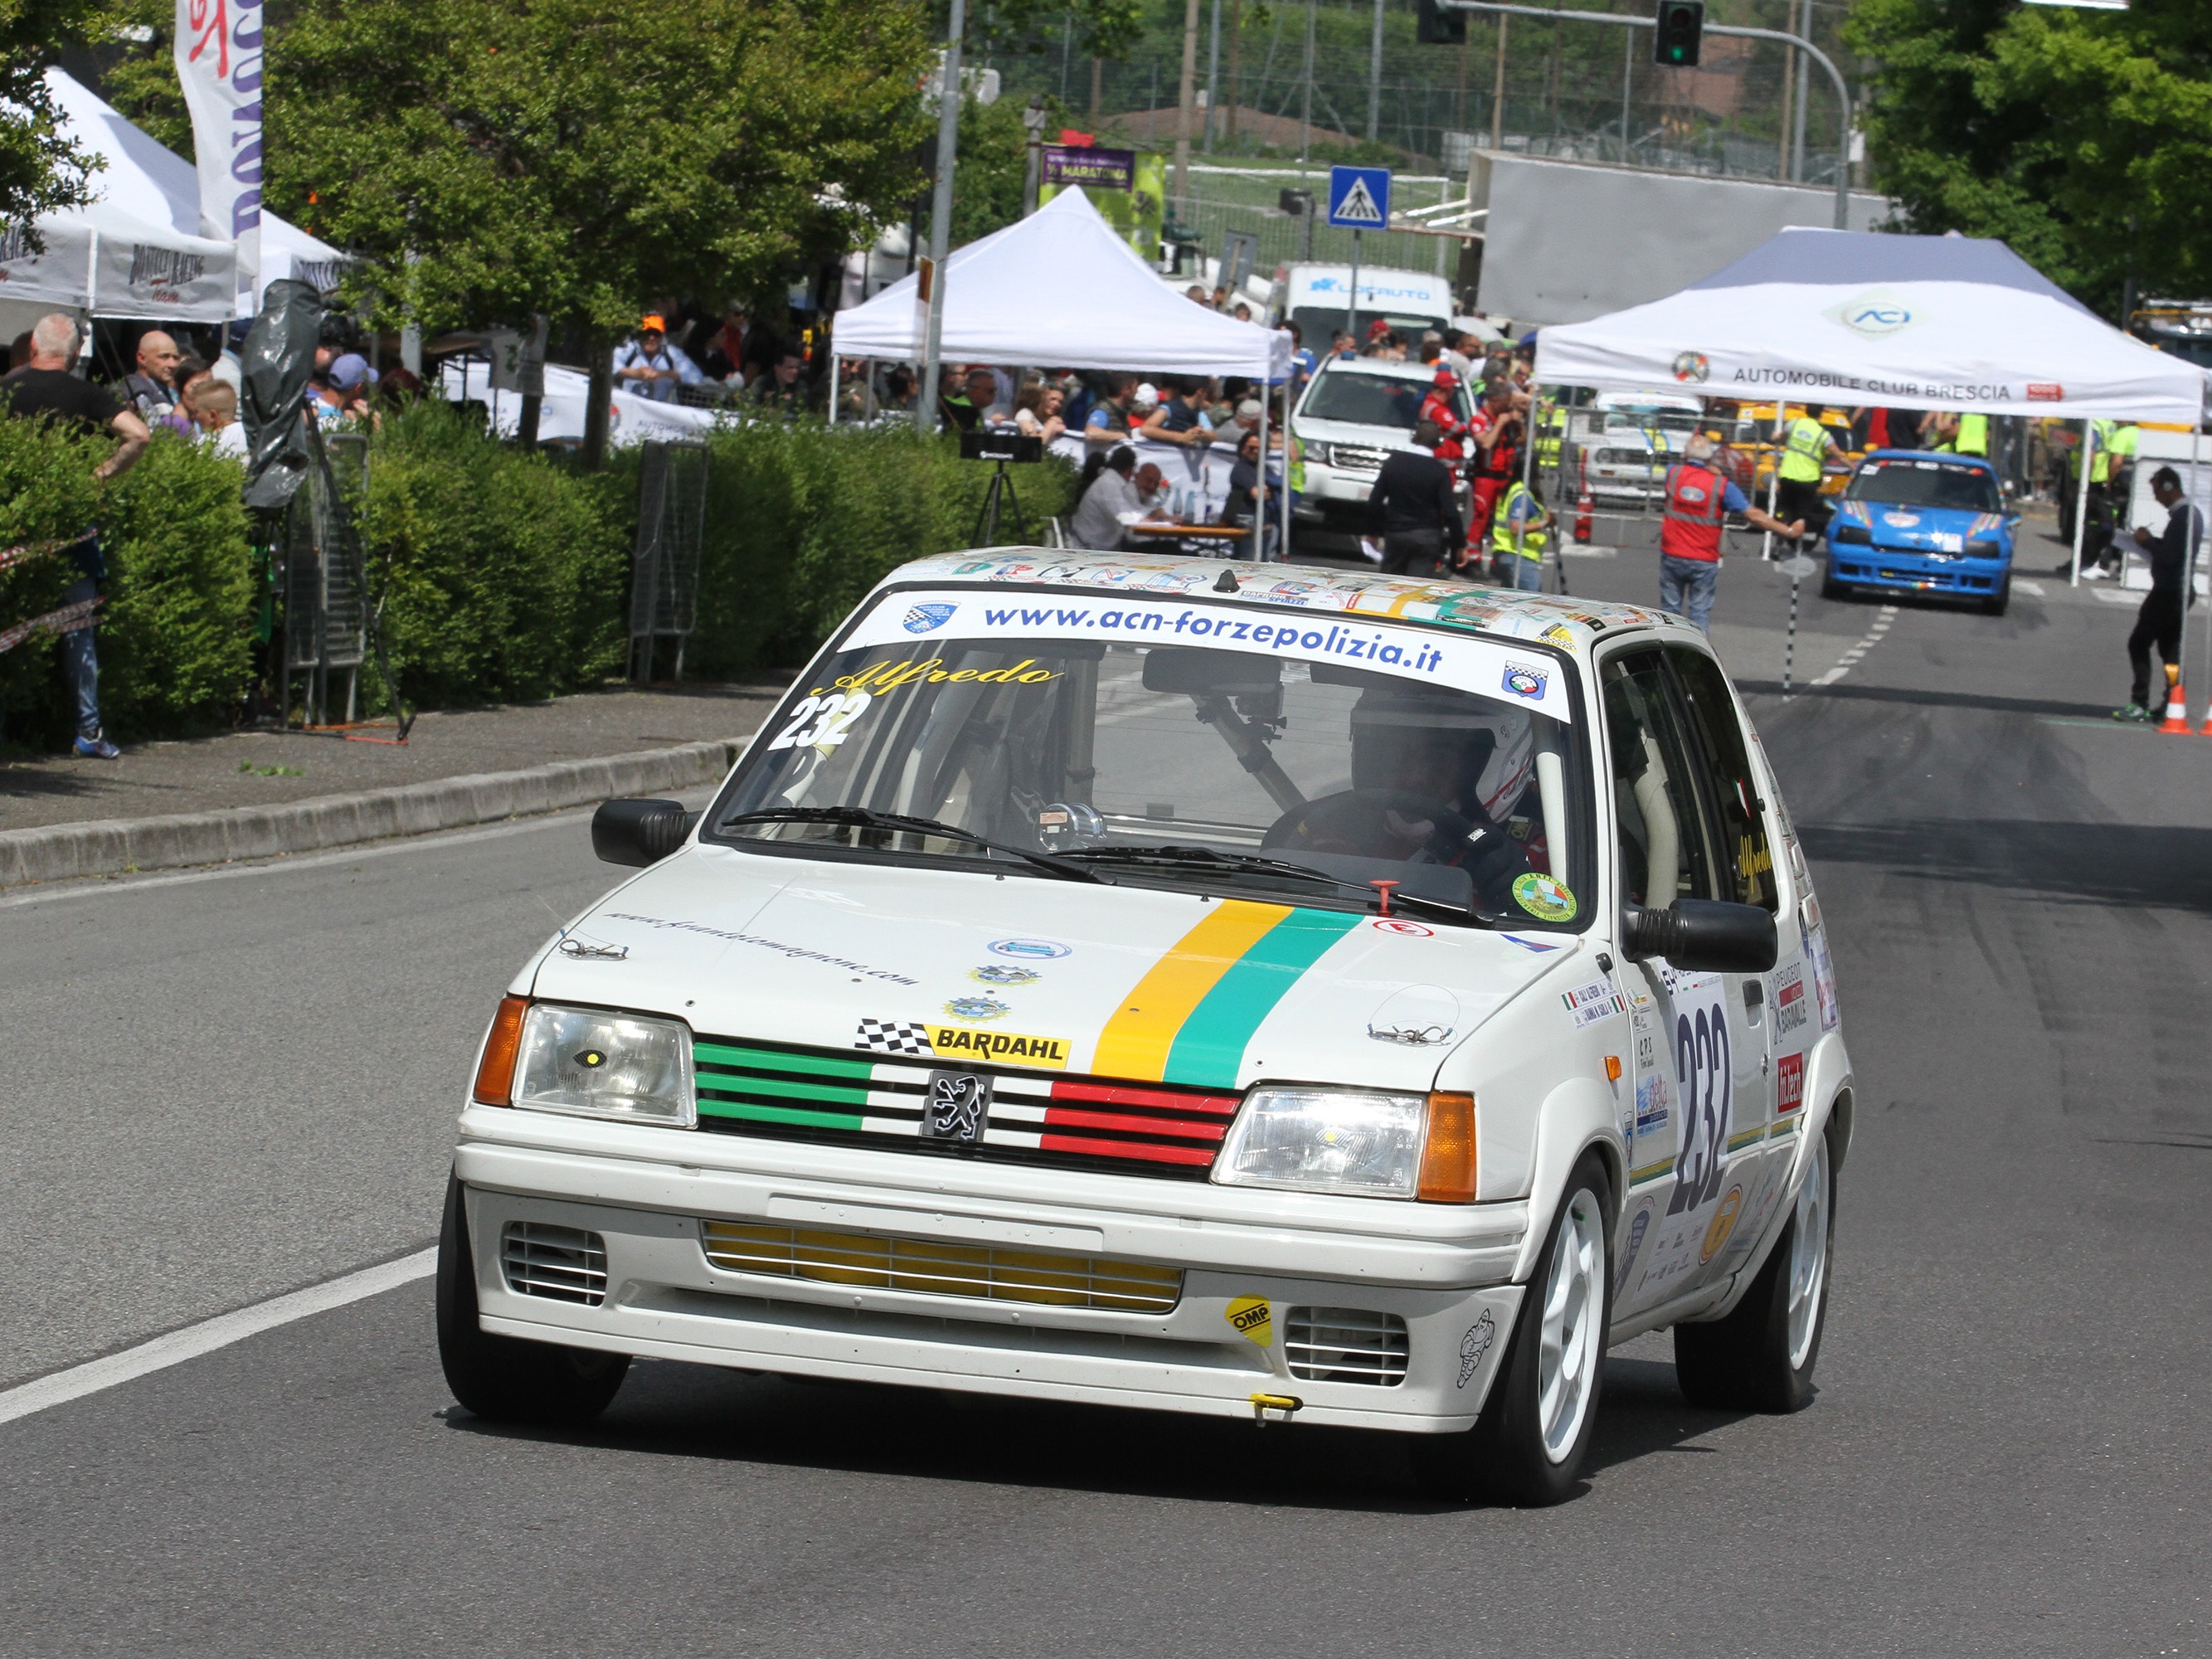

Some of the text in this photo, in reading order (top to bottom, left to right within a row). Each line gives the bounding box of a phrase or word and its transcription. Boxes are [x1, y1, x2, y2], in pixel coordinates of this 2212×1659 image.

[1733, 367, 1860, 390] AUTOMOBILE
[1867, 380, 1918, 395] CLUB
[1925, 382, 2011, 400] BRESCIA
[985, 608, 1443, 673] www.acn-forzepolizia.it
[809, 658, 1066, 697] Alfredo
[767, 693, 873, 752] 232
[1738, 832, 1772, 894] Alfredo
[1776, 962, 1801, 989] PEUGEOT
[936, 1029, 1063, 1060] BARDAHL
[1665, 1002, 1730, 1218] 232
[1233, 1306, 1270, 1329] OMP
